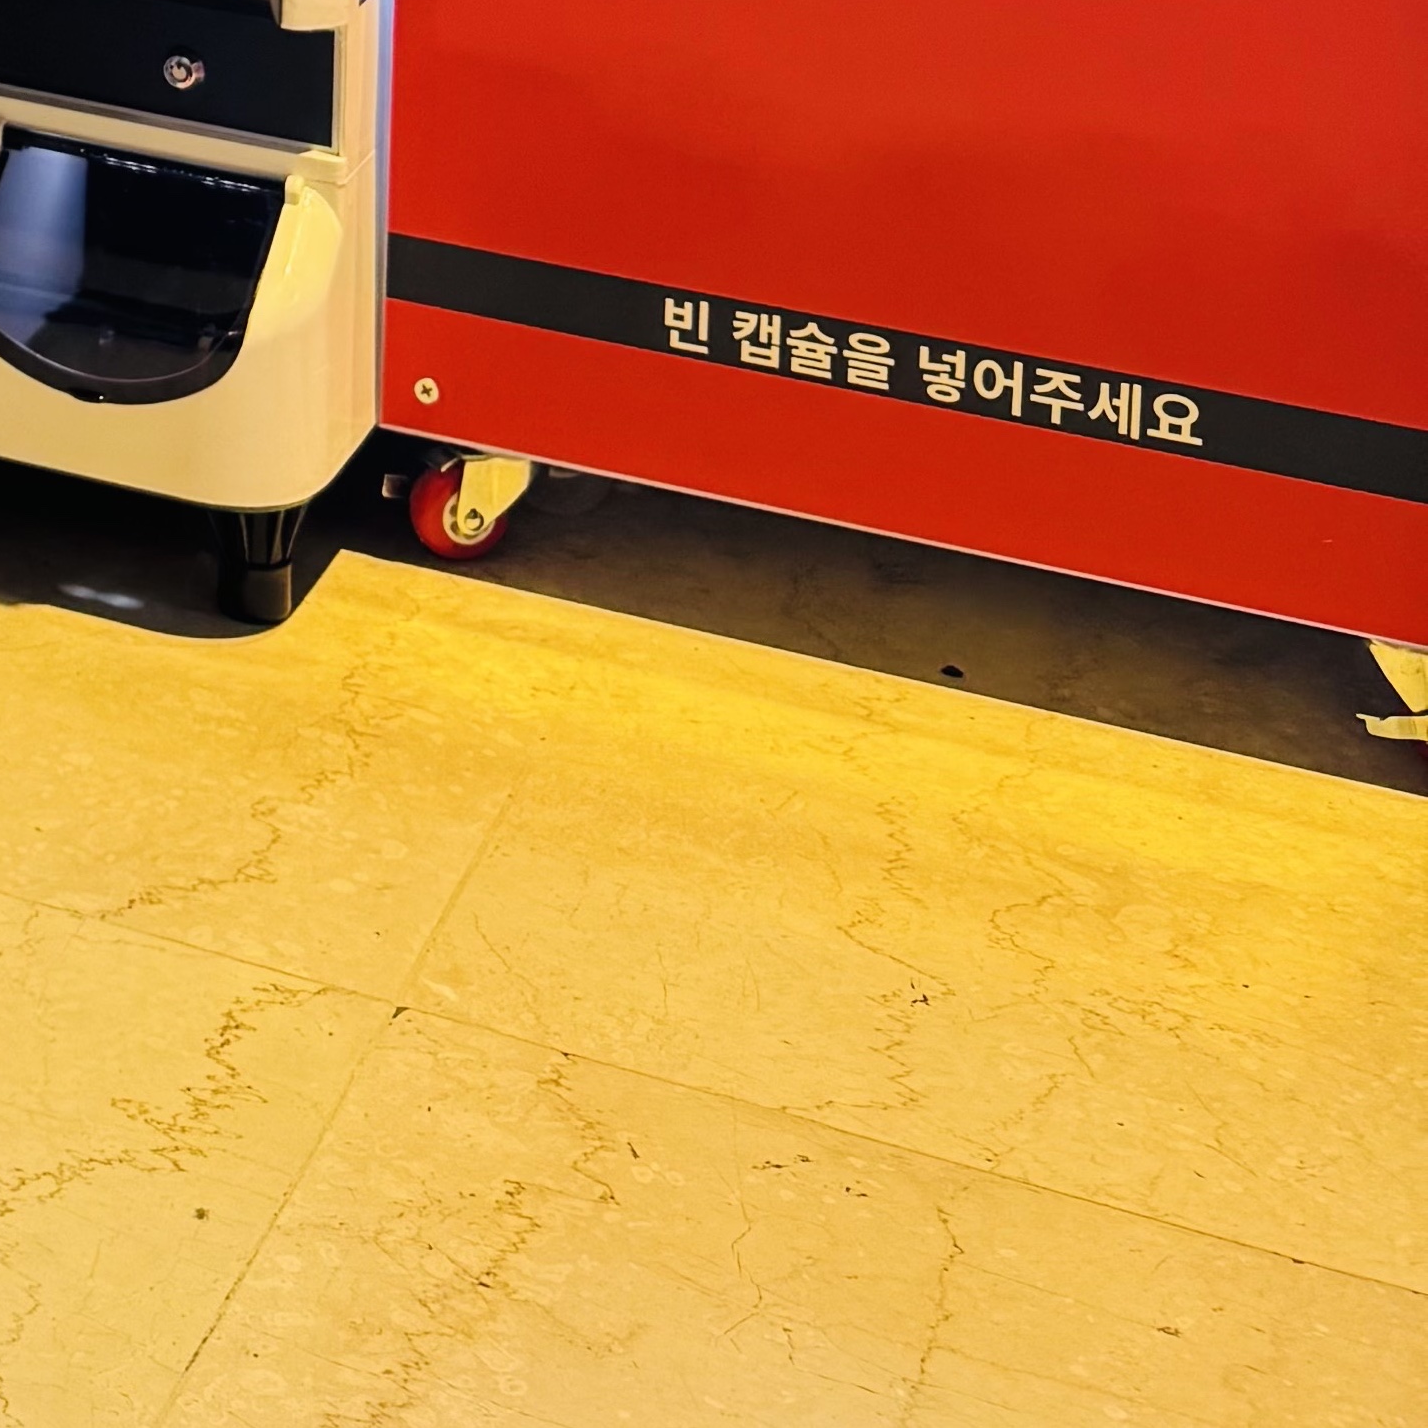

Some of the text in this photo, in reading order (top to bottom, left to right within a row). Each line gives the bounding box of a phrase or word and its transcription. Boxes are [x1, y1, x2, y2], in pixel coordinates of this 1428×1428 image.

[663, 297, 1204, 449] 빈 캡슐을 넣어주세요
